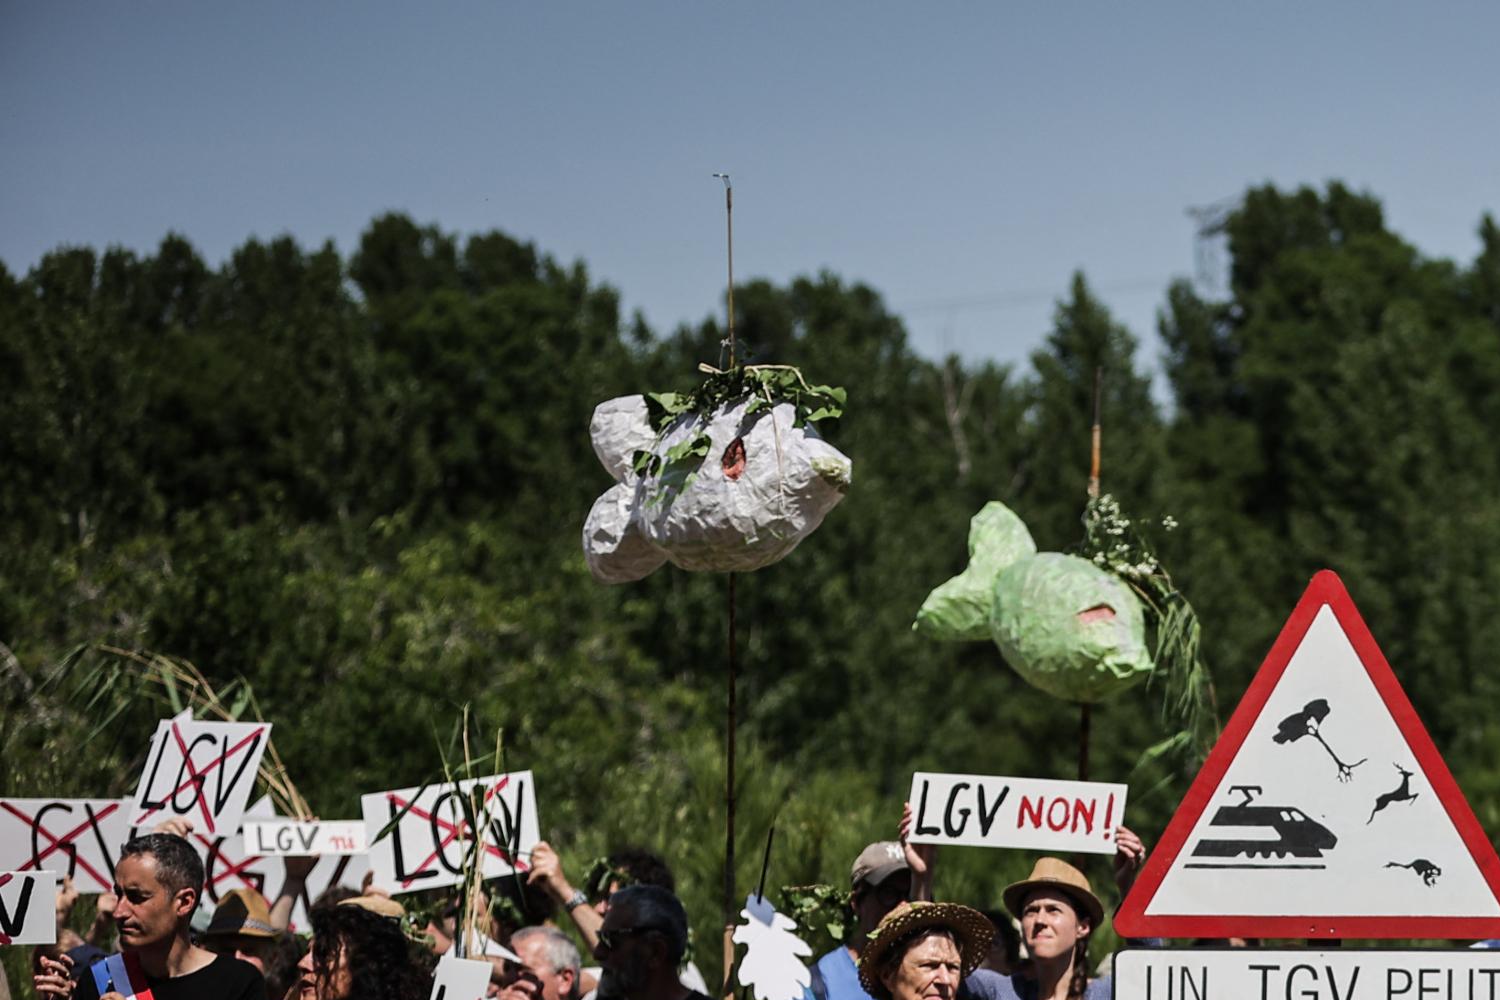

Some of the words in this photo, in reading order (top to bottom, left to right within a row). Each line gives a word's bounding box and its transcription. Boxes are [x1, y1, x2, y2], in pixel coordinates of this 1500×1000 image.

[140, 729, 261, 817] LGV
[915, 779, 1010, 838] LGV
[257, 825, 319, 852] LGV
